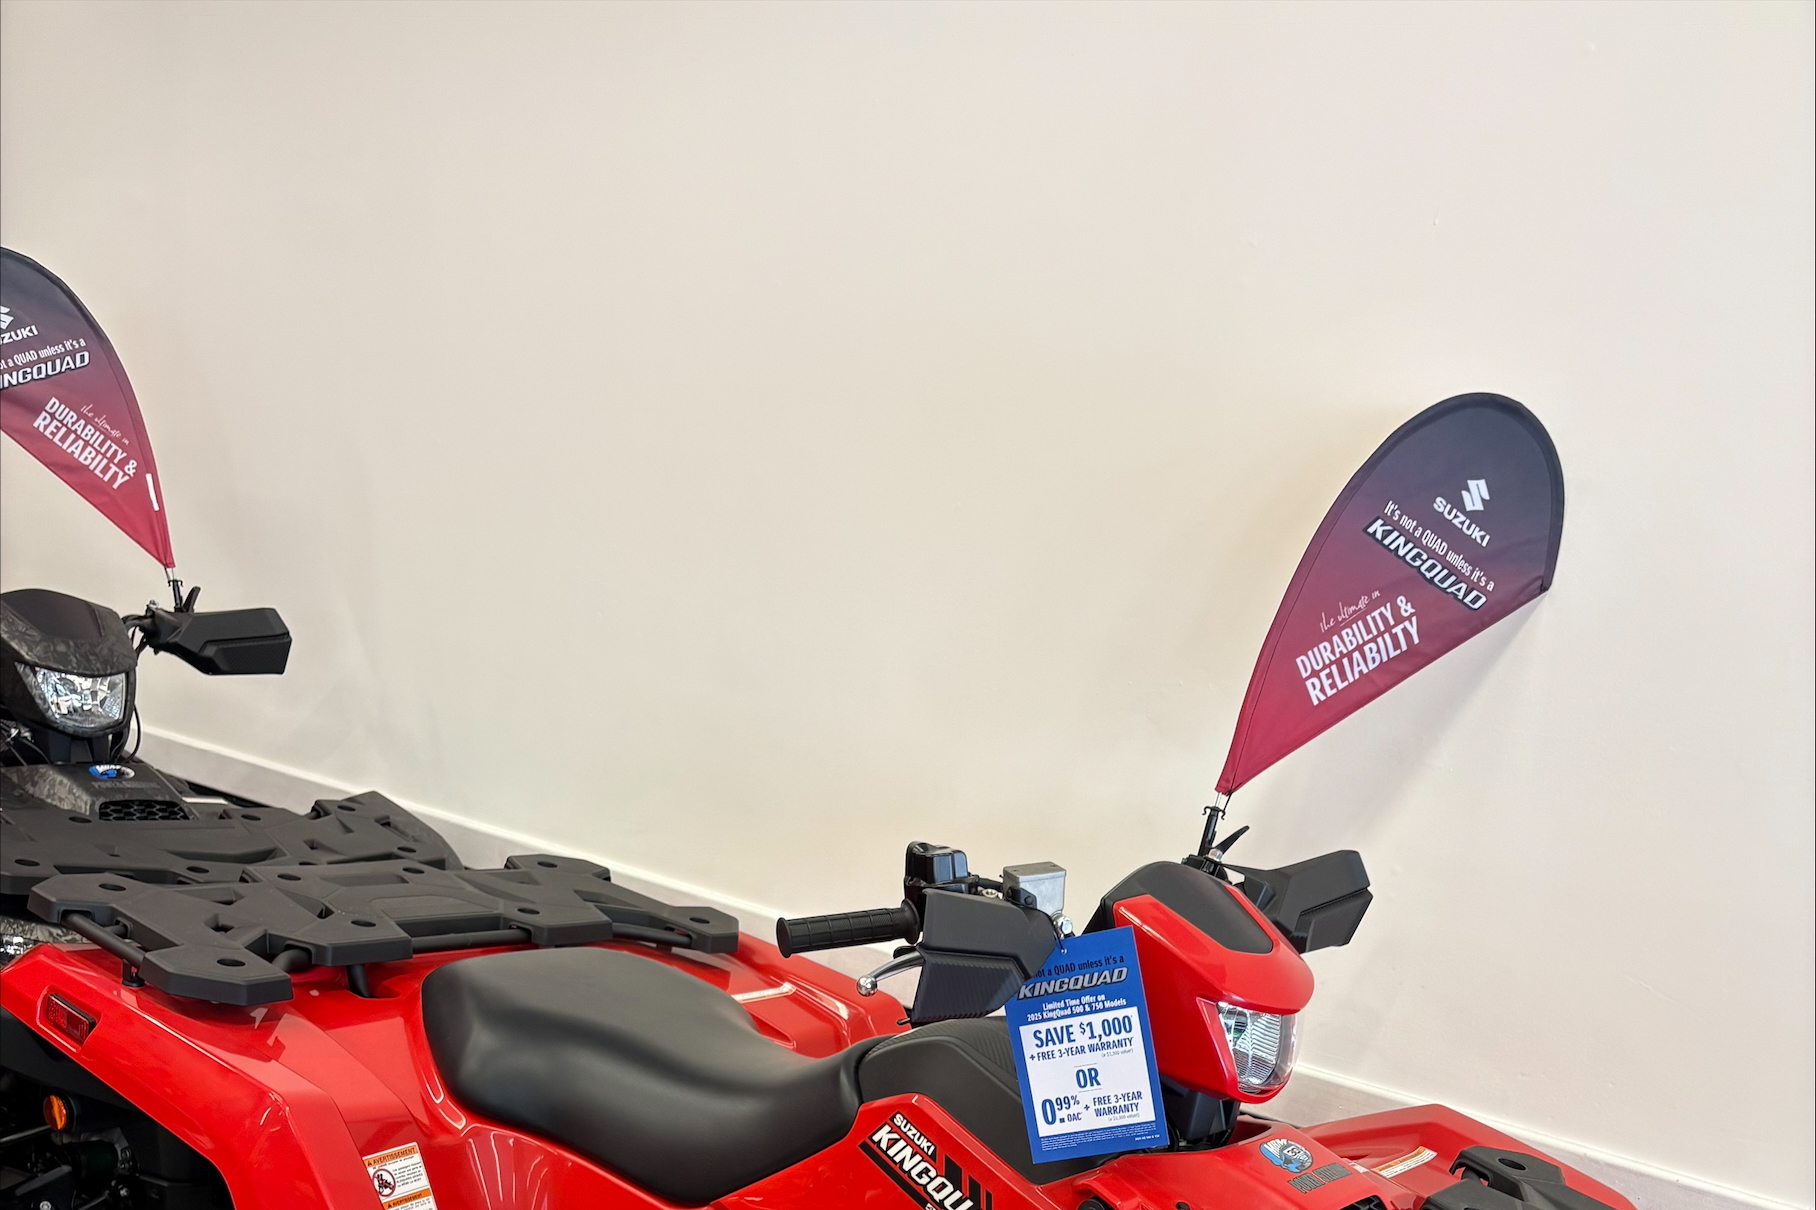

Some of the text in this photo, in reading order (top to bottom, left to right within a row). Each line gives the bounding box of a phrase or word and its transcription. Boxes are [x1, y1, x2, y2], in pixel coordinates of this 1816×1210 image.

[0, 325, 38, 345] ZUKI
[7, 358, 14, 367] a
[13, 350, 38, 366] QUAD
[38, 344, 65, 358] unless
[63, 338, 79, 351] it's
[79, 338, 86, 347] a
[0, 350, 90, 389] INGQUAD
[44, 396, 138, 478] DURABILITY &
[94, 414, 122, 437] ultimate
[33, 410, 131, 490] RELIABILTY
[1433, 496, 1491, 548] SUZUKI
[1384, 500, 1495, 592] It's not a QUAD unless it's a
[1366, 517, 1488, 610] KINGQUAD
[1320, 612, 1336, 633] the
[1337, 595, 1371, 624] ultimate
[1295, 595, 1416, 679] DURABILITY &
[1305, 616, 1421, 706] RELIABILTY
[1047, 968, 1053, 976] a
[1054, 962, 1076, 976] QUAD
[1078, 959, 1103, 971] unless
[1104, 955, 1118, 966] it's
[1119, 955, 1125, 963] a
[1018, 967, 1128, 1000] KINGQUAD
[1027, 998, 1127, 1022] 2025 KingQuad 500 & 750 Models
[1042, 993, 1106, 1011] Limited Time Offer on
[1033, 1024, 1076, 1049] SAVE
[1037, 1049, 1056, 1061] FREE
[1057, 1045, 1086, 1058] 3-YEAR
[1087, 1037, 1134, 1053] WARRANTY
[1075, 1067, 1102, 1090] OR
[1093, 1091, 1143, 1107] FREE 3-YEAR
[1094, 1102, 1140, 1118] WARRANTY
[893, 1113, 936, 1156] SUZUKI
